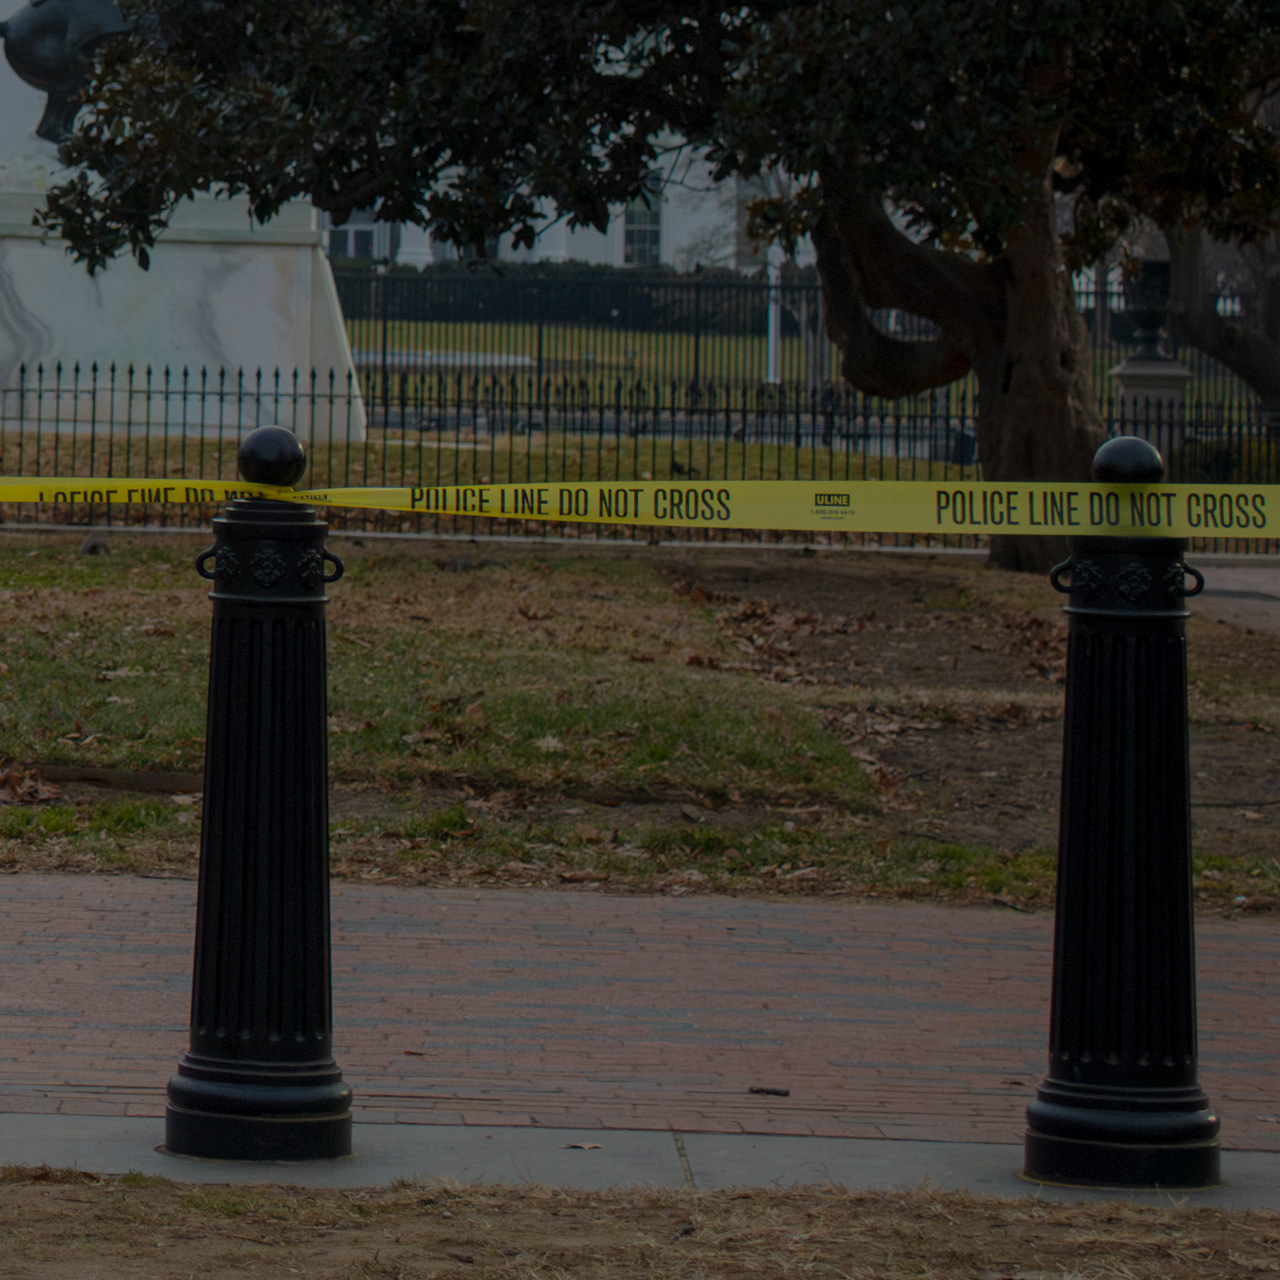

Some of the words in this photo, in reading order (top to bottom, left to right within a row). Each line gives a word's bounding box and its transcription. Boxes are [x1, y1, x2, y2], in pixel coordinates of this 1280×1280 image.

[411, 488, 490, 513] POLICE
[500, 488, 550, 515] LINE
[559, 488, 588, 517] DO
[598, 488, 644, 518] NOT
[654, 488, 731, 520] CROSS
[815, 494, 849, 506] ULINE
[936, 490, 1019, 525] POLICE
[1029, 491, 1080, 525] LINE
[1090, 492, 1120, 526] DO
[1130, 492, 1176, 527] NOT
[1186, 493, 1266, 529] CROSS
